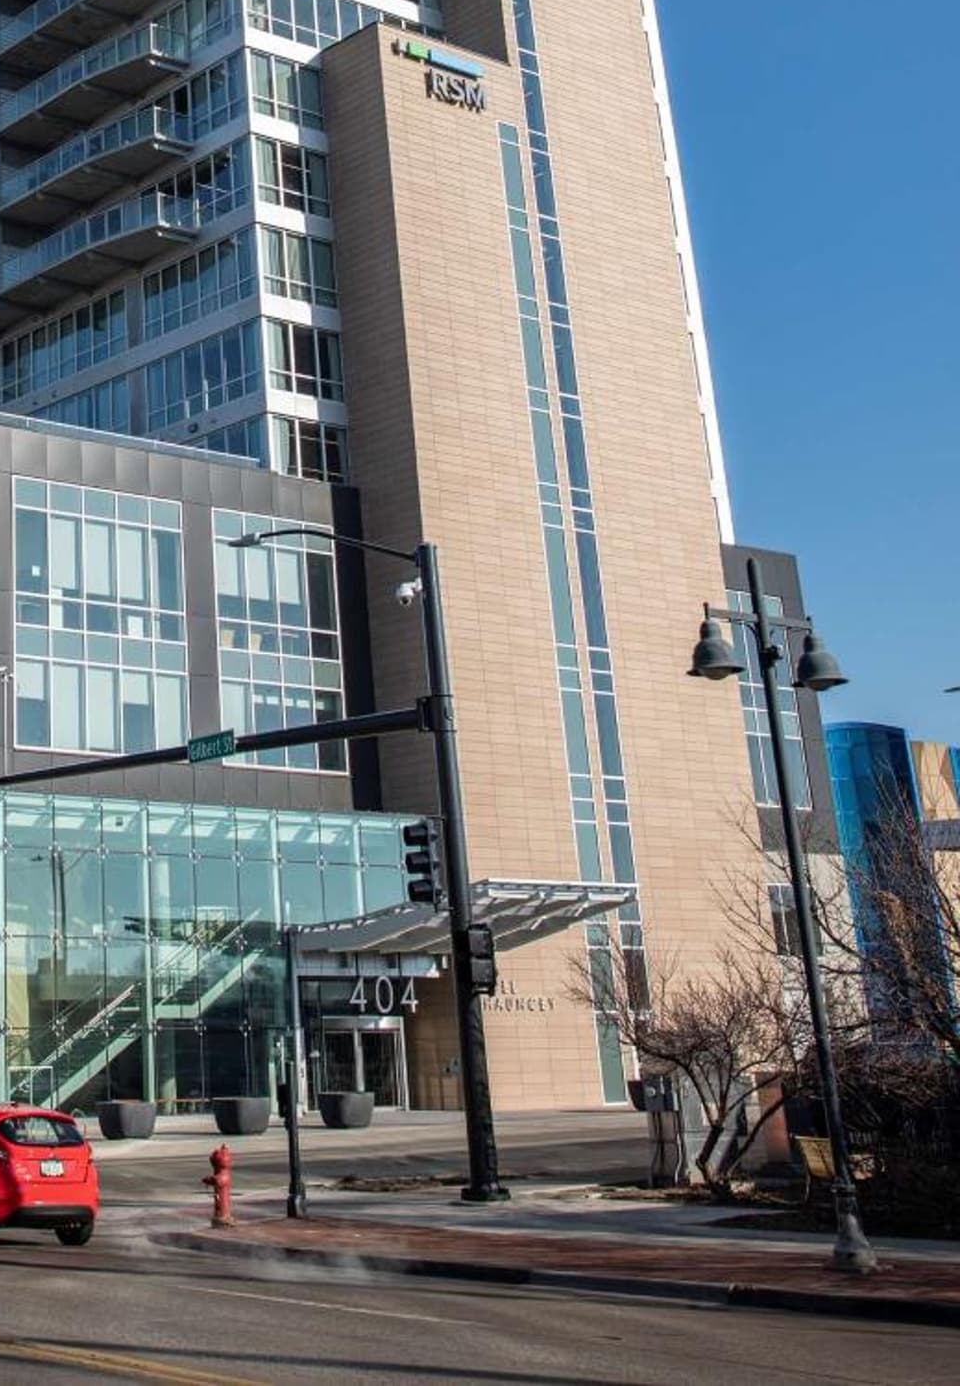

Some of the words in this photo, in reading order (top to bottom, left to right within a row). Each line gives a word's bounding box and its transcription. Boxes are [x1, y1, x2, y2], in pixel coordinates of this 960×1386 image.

[425, 68, 488, 113] RSM
[190, 737, 221, 760] Gilbert
[349, 975, 419, 1013] 404
[481, 998, 556, 1012] HAUNCEY
